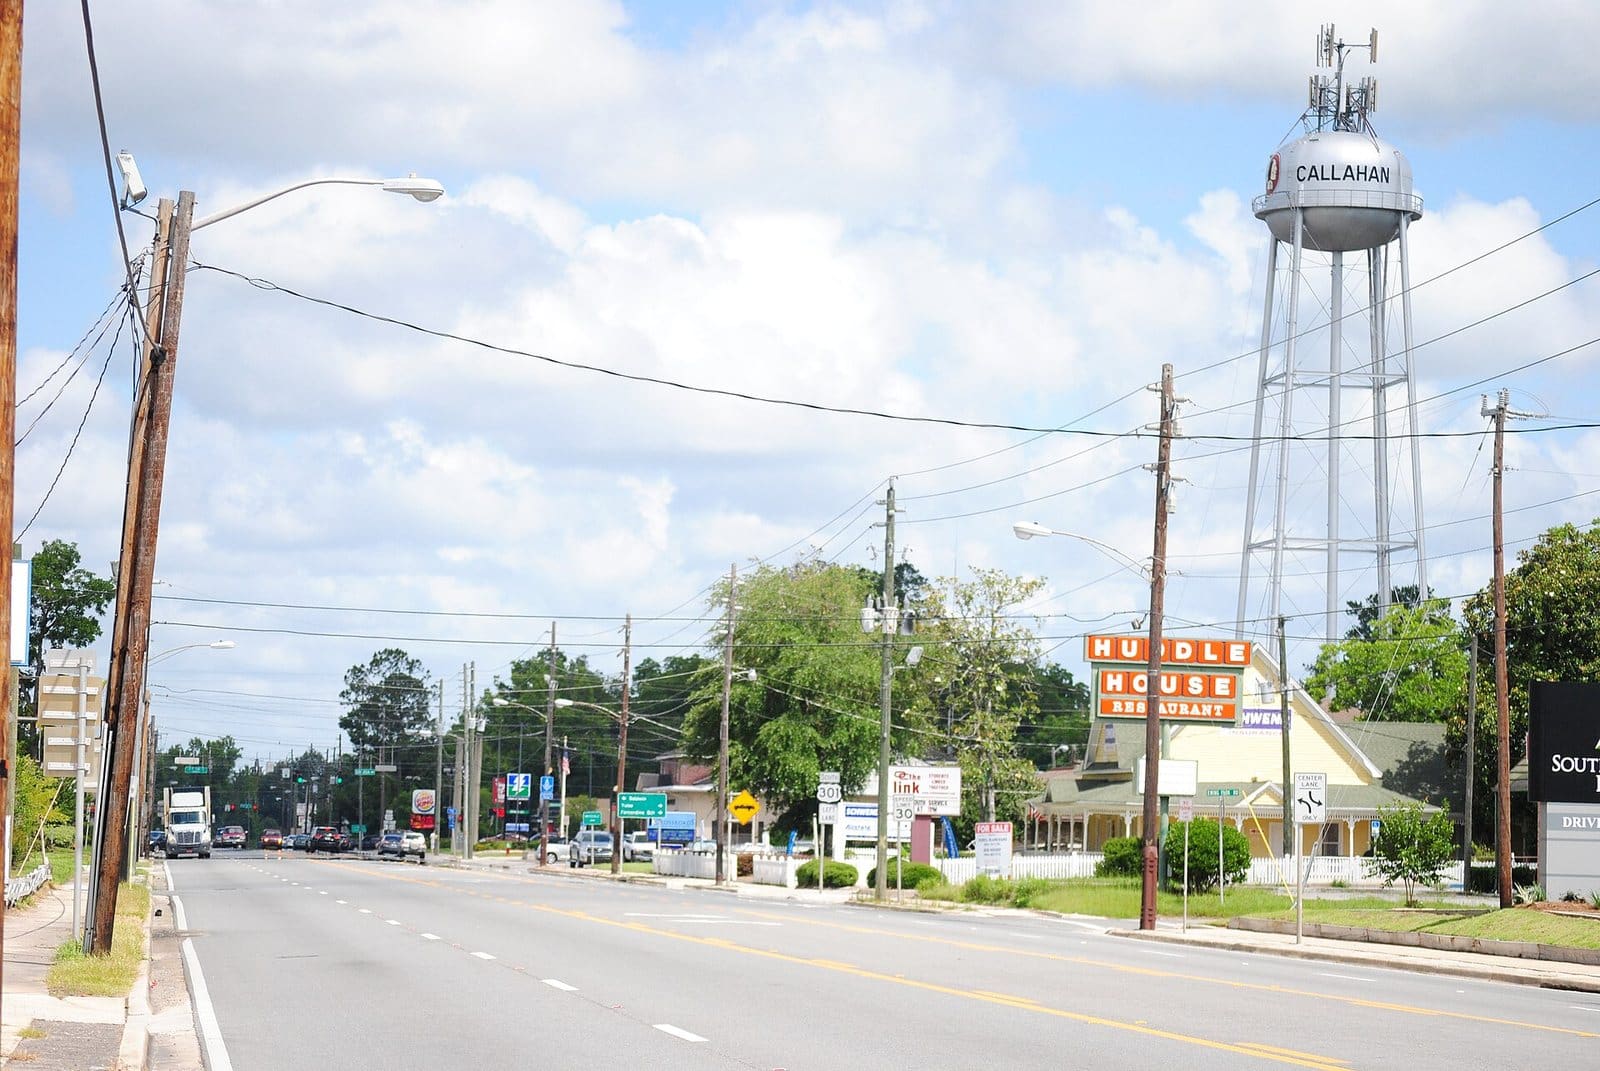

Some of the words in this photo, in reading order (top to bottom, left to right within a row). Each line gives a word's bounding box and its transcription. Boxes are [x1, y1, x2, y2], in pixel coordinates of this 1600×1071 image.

[1296, 165, 1390, 183] CALLAHAN
[1095, 639, 1245, 662] HUDLE
[1106, 674, 1230, 696] HOUSE
[1112, 701, 1223, 716] RESAURANT
[1552, 754, 1600, 773] SOUT
[819, 787, 840, 798] 301
[893, 781, 919, 793] link
[896, 808, 913, 819] 30
[977, 824, 991, 833] FOR
[991, 824, 1008, 833] SALE
